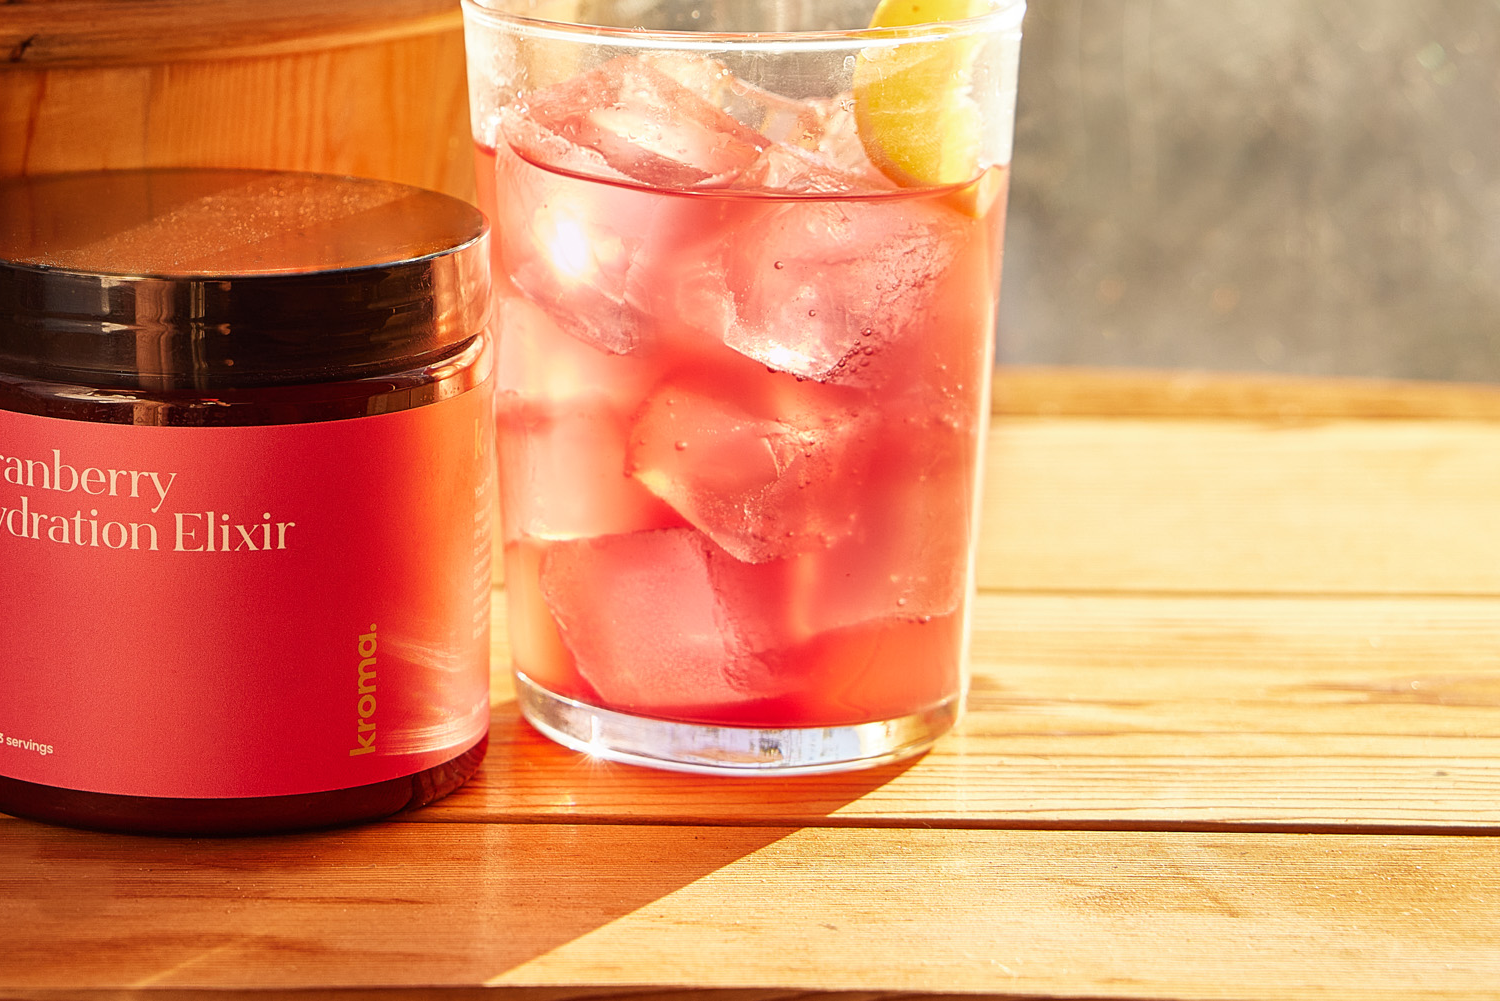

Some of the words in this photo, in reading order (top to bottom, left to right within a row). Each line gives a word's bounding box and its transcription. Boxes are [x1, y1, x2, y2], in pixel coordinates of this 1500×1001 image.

[173, 511, 296, 553] Elixir
[349, 622, 378, 757] kroma.
[6, 736, 54, 756] servings
